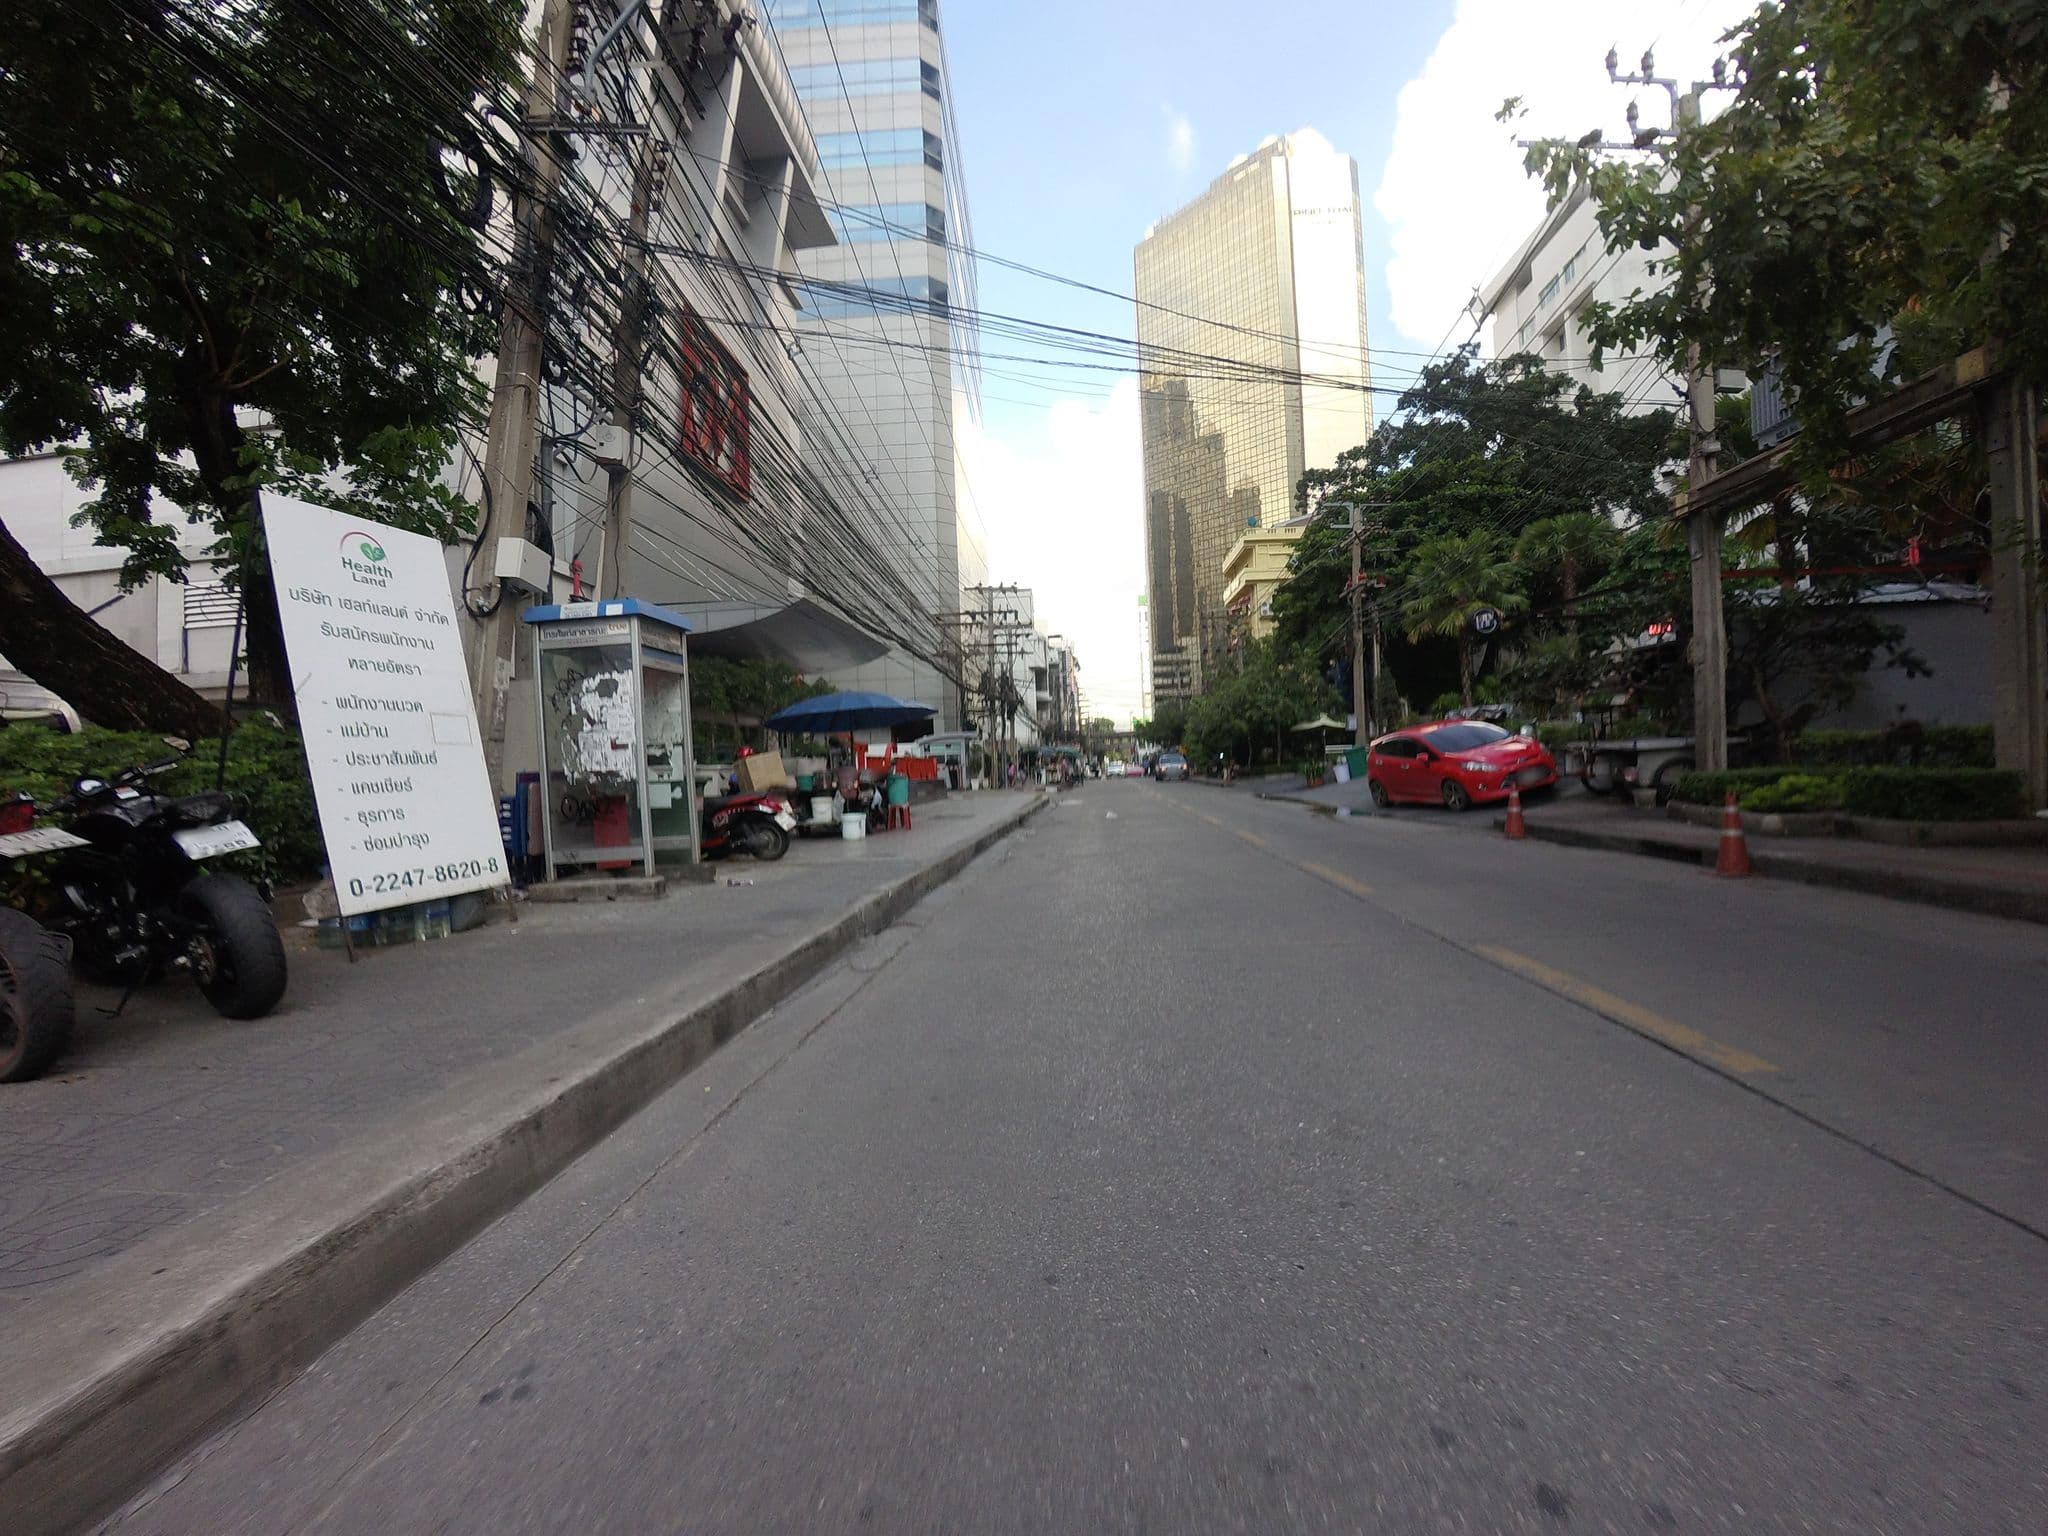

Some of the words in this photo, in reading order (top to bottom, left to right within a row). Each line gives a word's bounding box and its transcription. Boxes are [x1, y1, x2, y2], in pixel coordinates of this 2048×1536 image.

[341, 557, 393, 579] Health
[352, 572, 387, 588] Land
[288, 587, 333, 607] บริษัท
[338, 597, 409, 620] เฮลท์แลนด์
[414, 609, 450, 626] จำกัด
[320, 621, 435, 651] รับสมัครพนักงาน
[348, 657, 423, 676] หลายอัตรา
[336, 694, 424, 713] พนักงานนวด
[340, 722, 389, 738] แม่บ้าน
[345, 750, 438, 767] ประชาสัมพันธ์
[351, 776, 413, 795] แคชเชียร์
[357, 807, 405, 828] ธุรการ
[364, 832, 430, 852] ซ่อมบำรุง
[350, 857, 499, 897] 0-2247-8620-8
